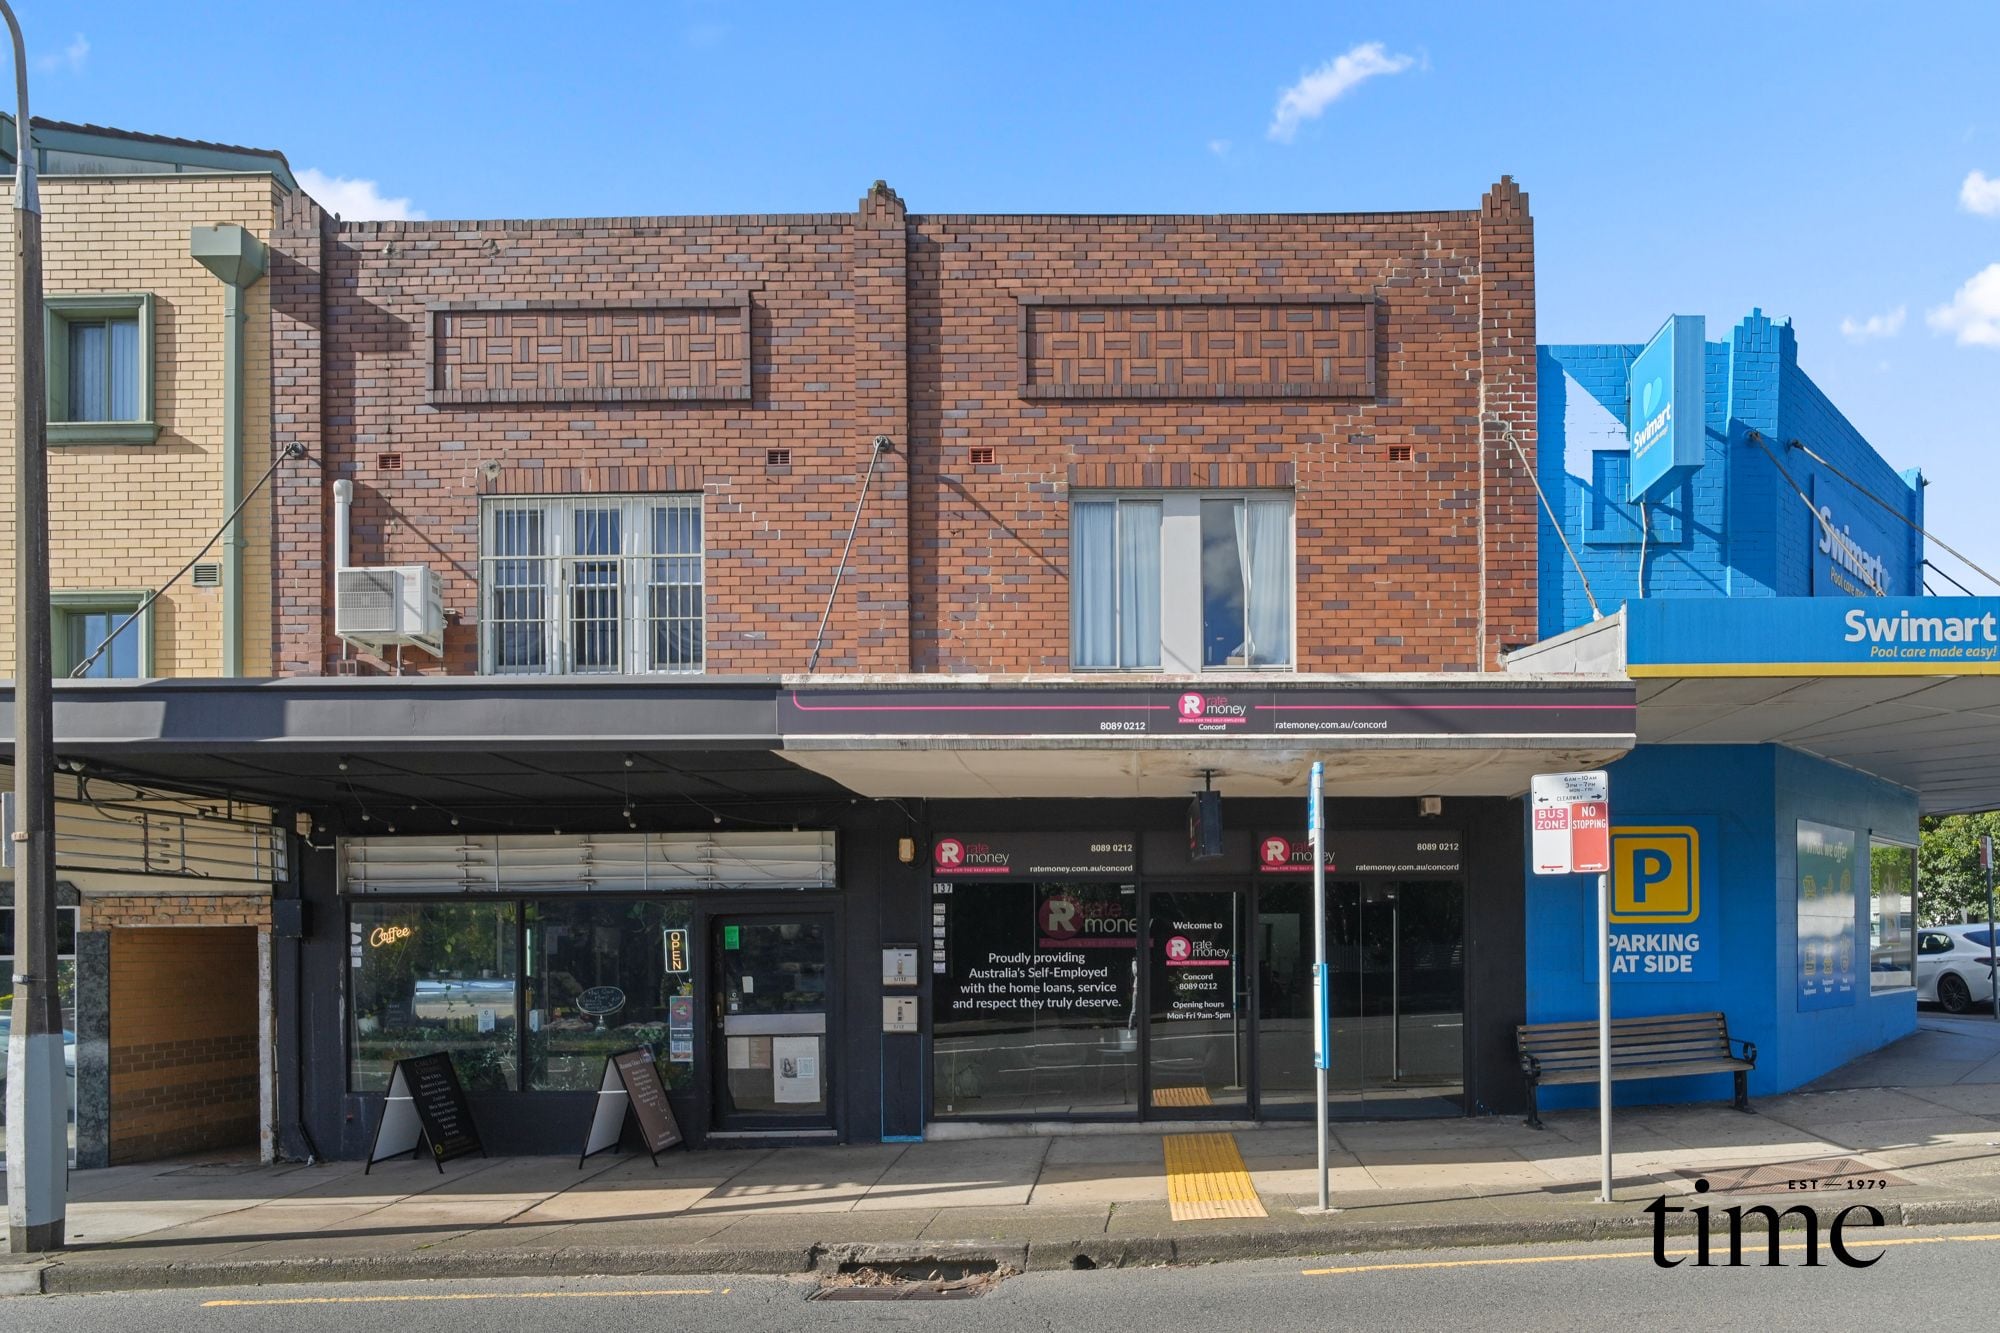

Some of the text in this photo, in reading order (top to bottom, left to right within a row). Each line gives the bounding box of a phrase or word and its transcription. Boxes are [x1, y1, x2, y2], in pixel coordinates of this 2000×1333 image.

[1634, 401, 1671, 453] Swimart
[1845, 609, 1997, 642] Swimart
[1871, 646, 1997, 660] Pool care made easy!
[1206, 696, 1229, 706] rate
[1206, 704, 1247, 716] money
[1100, 722, 1146, 731] 8089 0212
[1275, 720, 1388, 730] ratemoney.com.au/concord
[1539, 809, 1564, 819] BUS
[1581, 805, 1596, 817] NO
[1537, 820, 1566, 830] ZONE
[1572, 818, 1606, 830] STOPPING
[967, 842, 989, 853] rate
[1091, 844, 1133, 852] 8089 0212
[1417, 843, 1459, 851] 8089 0212
[1822, 842, 1833, 857] we
[1833, 841, 1848, 863] offer
[966, 852, 1010, 866] money
[1292, 851, 1336, 864] moey
[1030, 865, 1133, 874] ratemoney.com.au/concord
[1355, 864, 1459, 872] ratemoney.com.au/concord
[1633, 849, 1672, 903] P
[934, 884, 952, 893] 137
[370, 927, 410, 947] Coffee
[1609, 934, 1700, 952] PARKING
[1192, 940, 1212, 949] rate
[671, 932, 681, 970] OPEN
[1192, 948, 1229, 959] money
[988, 952, 1085, 964] Proudly providing
[1612, 955, 1692, 973] AT SIDE
[969, 966, 1108, 979] Australia's Self-Employed
[960, 981, 1117, 993] with the home loans, service
[953, 996, 1121, 1010] and respect they truly deserve.
[1173, 1001, 1203, 1009] Opening
[1167, 1012, 1231, 1020] Mon-Fri 9am-5pm
